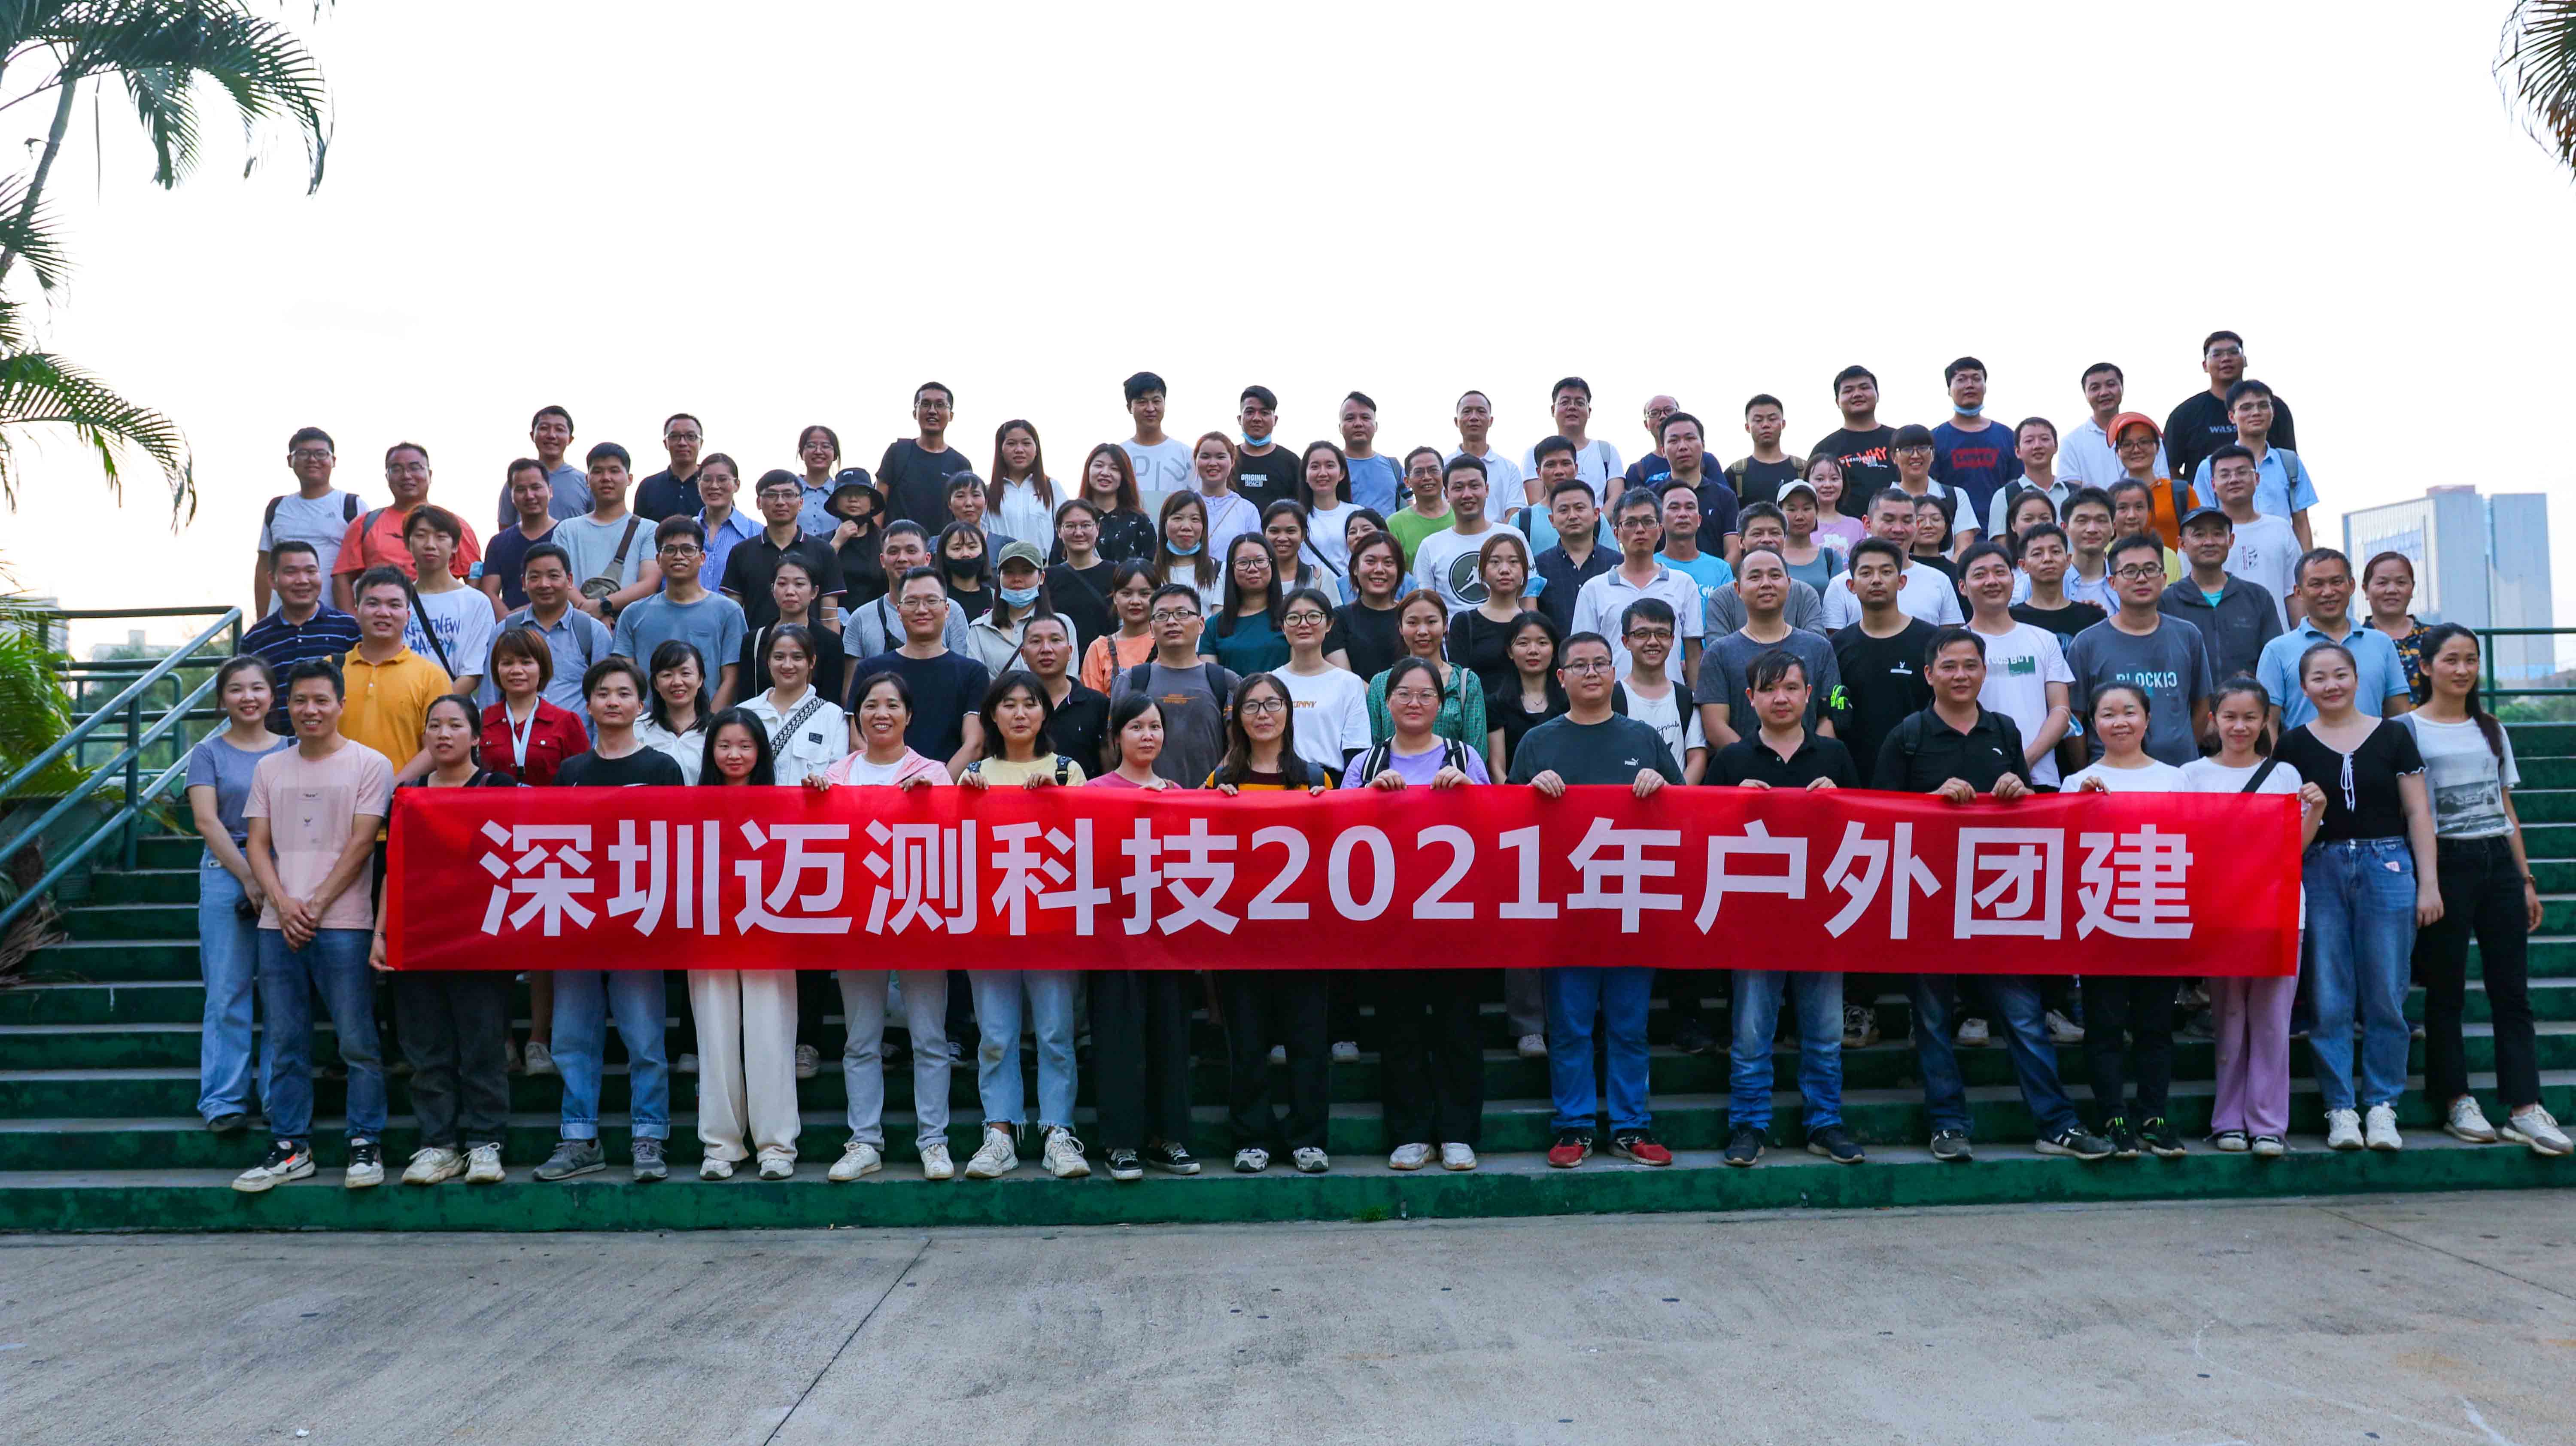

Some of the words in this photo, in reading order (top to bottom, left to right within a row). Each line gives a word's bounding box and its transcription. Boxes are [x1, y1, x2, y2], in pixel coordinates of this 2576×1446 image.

[480, 817, 2193, 941] 深圳迈测科技2021年户外团建
